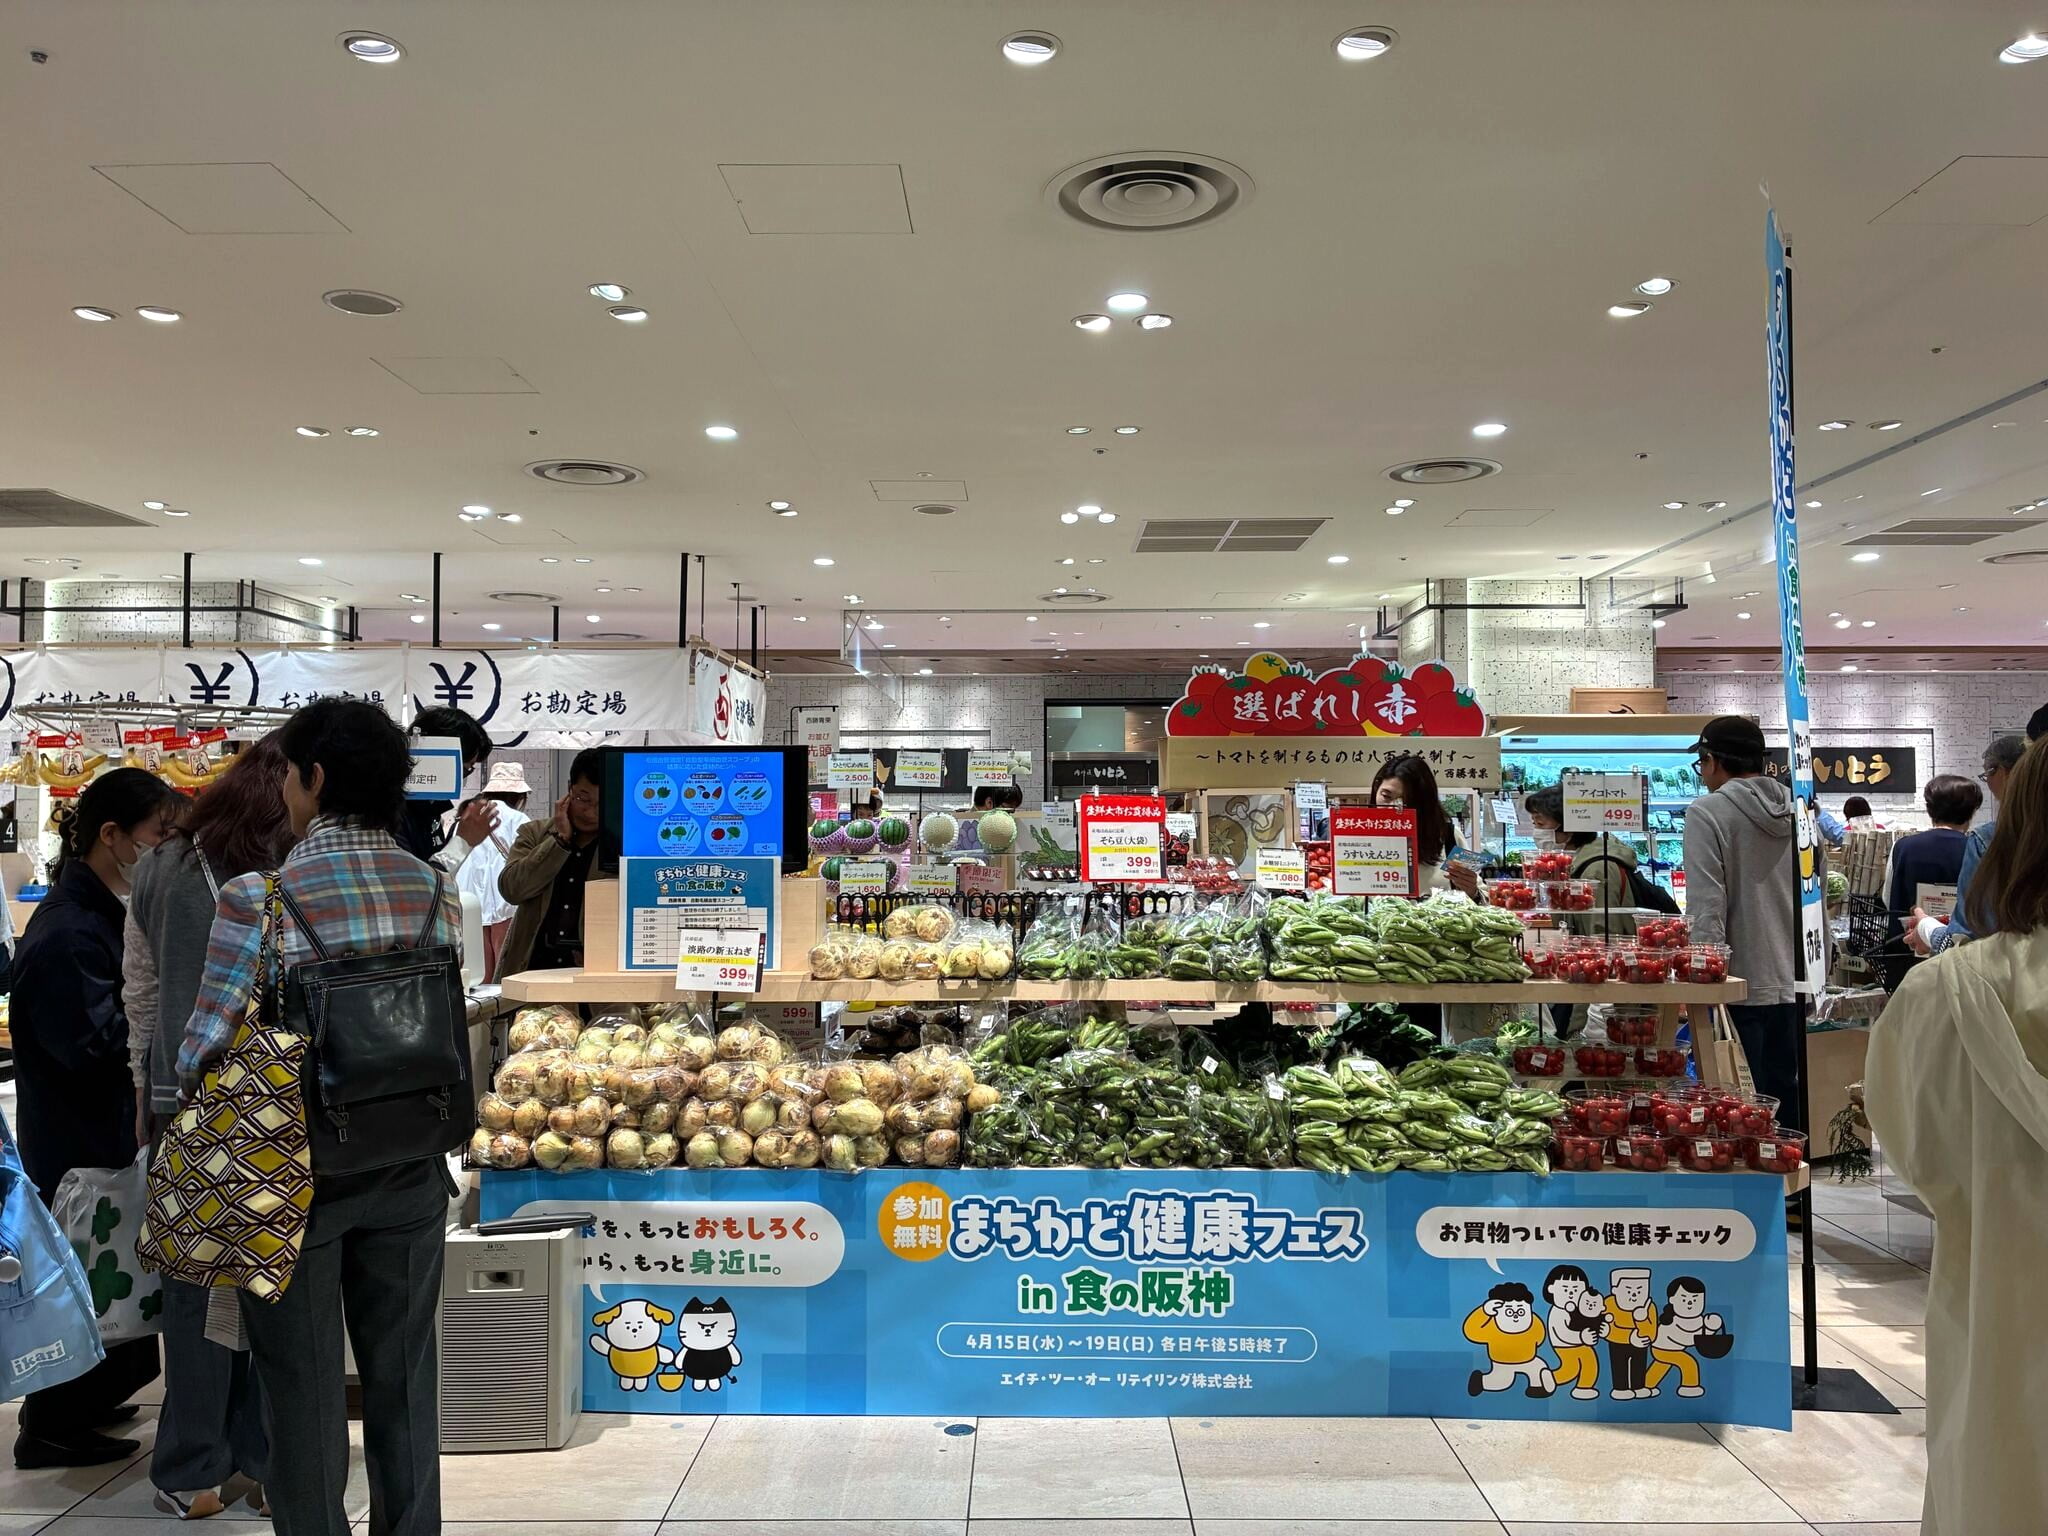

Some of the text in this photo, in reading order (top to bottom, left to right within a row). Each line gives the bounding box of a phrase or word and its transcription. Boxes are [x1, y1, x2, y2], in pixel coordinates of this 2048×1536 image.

[521, 690, 627, 715] お勘定場
[1233, 683, 1417, 725] 選ばれし赤
[808, 744, 832, 757] 先頭
[1444, 767, 1489, 779] 西勝青果
[1813, 753, 1891, 785] いとう
[1579, 788, 1627, 799] アイコトマト
[6, 821, 14, 838] 4
[1343, 850, 1400, 860] うすいえんどう
[656, 863, 748, 882] まちかど健康フェス
[675, 880, 726, 892] in 食の阪神
[687, 944, 752, 957] 淡路の新玉ねぎ
[892, 1195, 943, 1219] 参加
[952, 1191, 1364, 1260] まちかど健康フェス
[1439, 1222, 1732, 1247] お買物ついでの健康チェック
[892, 1224, 943, 1248] 無料
[1021, 1269, 1232, 1315] in 食の阪神
[1160, 1336, 1289, 1356] 各日午後5時終了
[14, 1341, 64, 1373] ikari
[1116, 1372, 1253, 1389] リテイリング株式会社
